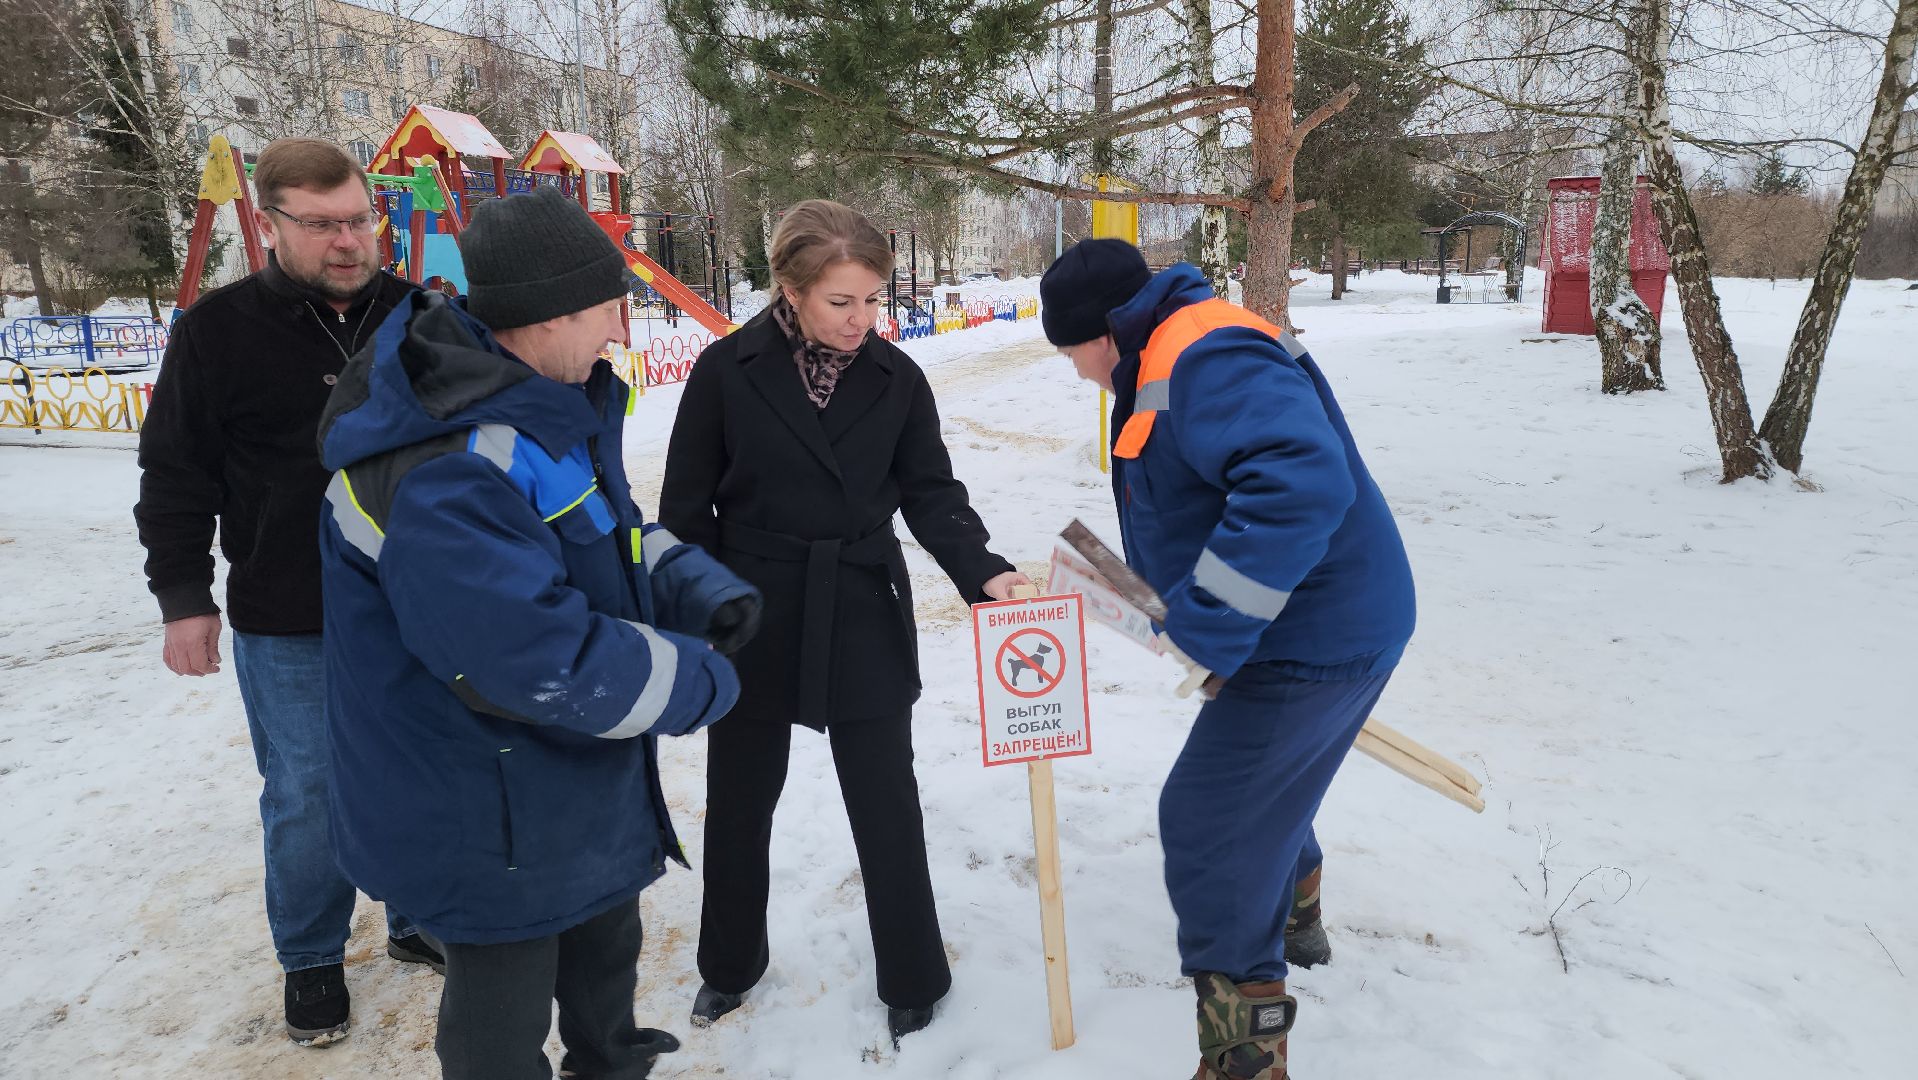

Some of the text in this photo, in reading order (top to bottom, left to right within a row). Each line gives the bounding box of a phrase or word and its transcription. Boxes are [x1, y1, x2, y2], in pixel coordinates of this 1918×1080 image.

[988, 603, 1069, 627] ВНИМАНИЕ!
[1006, 703, 1062, 719] ВЫГУЛ
[1008, 719, 1062, 735] СОБАК
[993, 730, 1082, 756] ЗАПРЕЩЁН!
